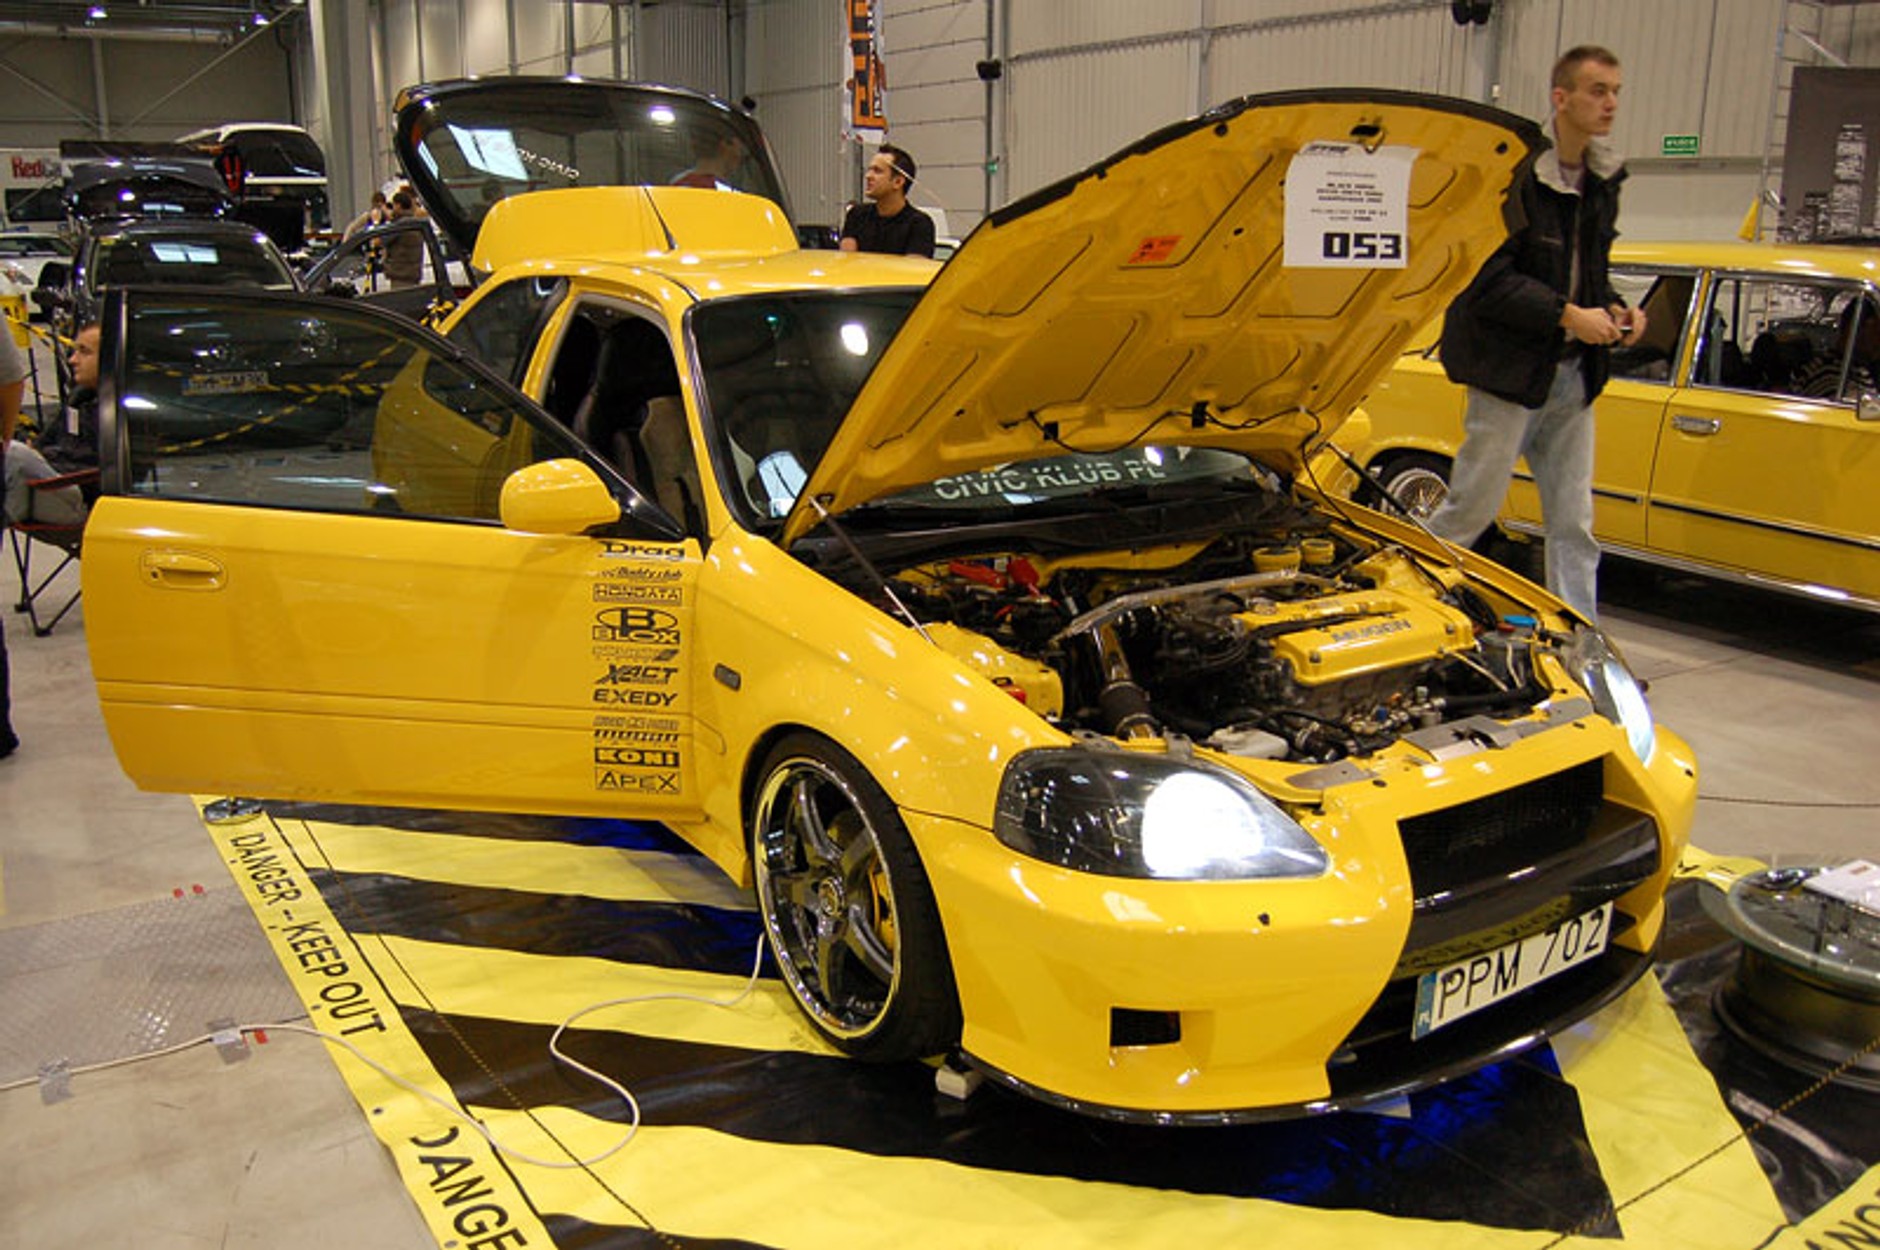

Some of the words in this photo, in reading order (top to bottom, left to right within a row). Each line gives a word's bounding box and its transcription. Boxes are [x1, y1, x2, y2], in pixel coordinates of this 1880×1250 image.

[1323, 232, 1402, 259] 053
[934, 469, 1027, 500] CIVIC
[1031, 462, 1121, 488] KLUB
[599, 540, 685, 560] Drag
[593, 625, 680, 644] BLOX
[593, 688, 678, 706] EXEDY
[596, 748, 679, 767] KONI
[229, 832, 302, 906] DANGER
[282, 920, 350, 978] KEEP
[319, 982, 387, 1036] OUT
[1438, 941, 1521, 1020] PPM
[1539, 909, 1604, 975] 702
